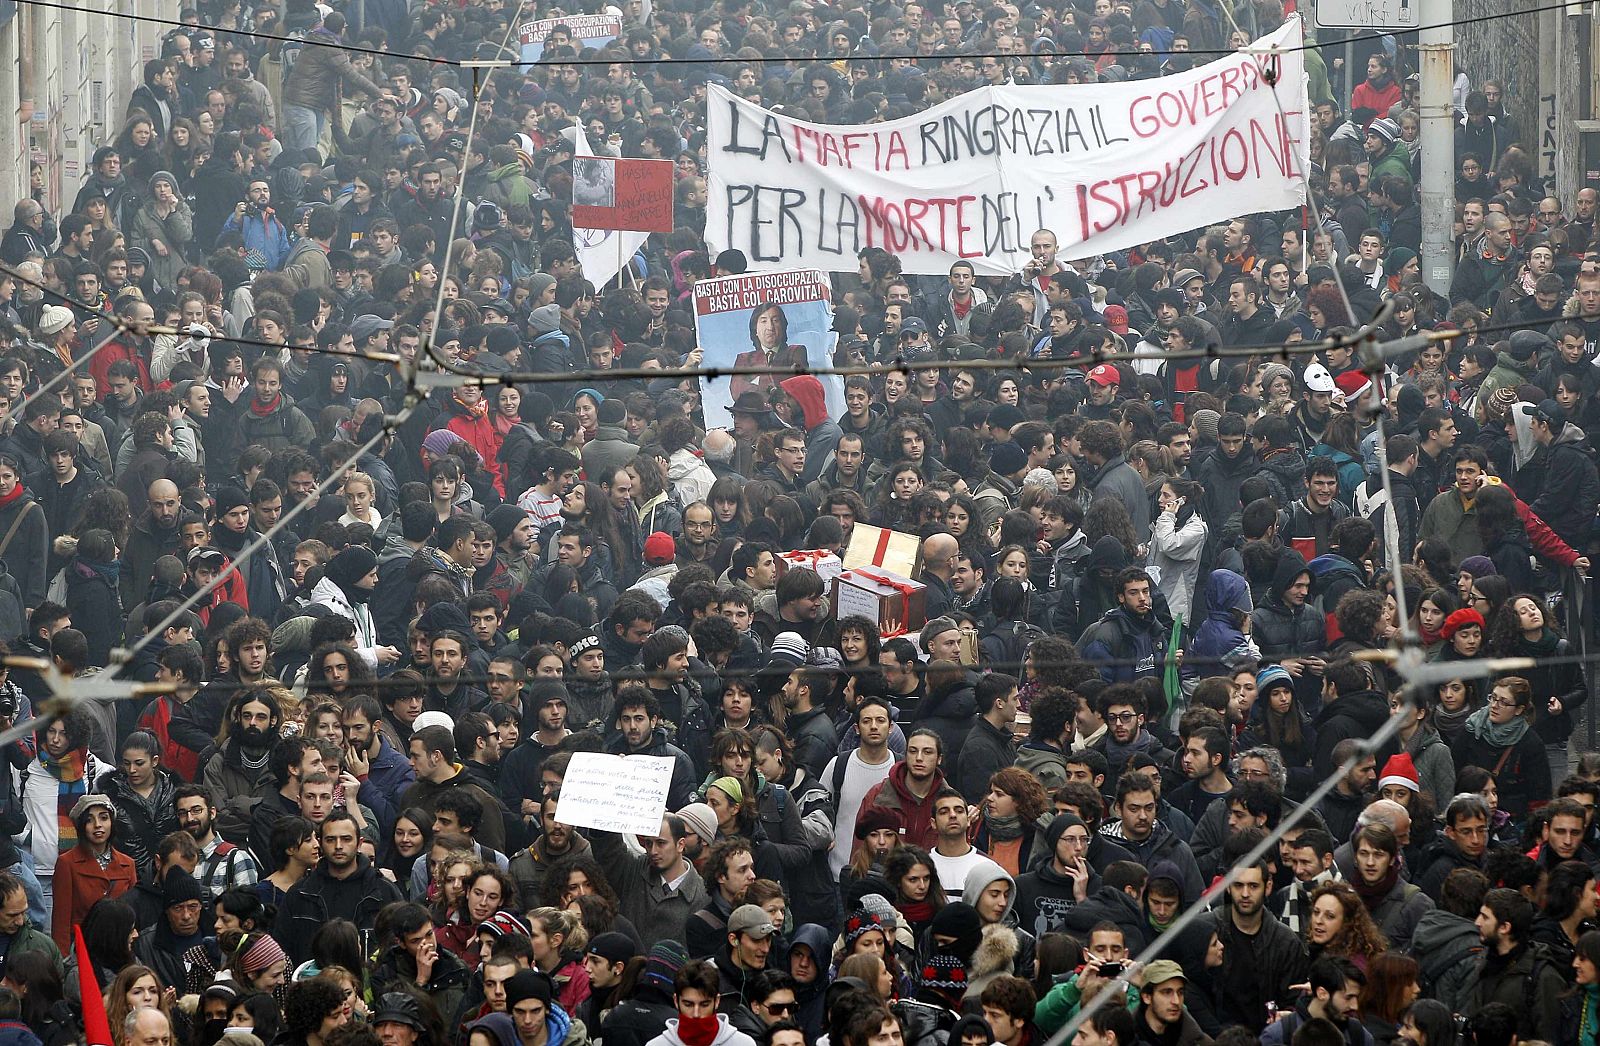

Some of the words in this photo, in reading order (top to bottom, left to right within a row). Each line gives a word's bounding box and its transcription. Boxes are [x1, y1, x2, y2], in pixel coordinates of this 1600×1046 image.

[722, 101, 791, 163] LA
[791, 123, 910, 171] MAFIA
[920, 104, 1088, 165] RINGRAZIA
[1089, 105, 1129, 148] IL
[1129, 53, 1281, 138] GOVERNO
[727, 185, 806, 262] PER
[818, 189, 859, 255] LA
[858, 195, 983, 258] MORTE
[1076, 111, 1302, 241] ISTRUZIONE
[696, 281, 720, 298] BASTA
[723, 279, 740, 293] CON
[742, 278, 753, 290] LA
[710, 293, 741, 312] BASTA
[743, 290, 763, 307] COL
[766, 284, 821, 304] CAROVITA!
